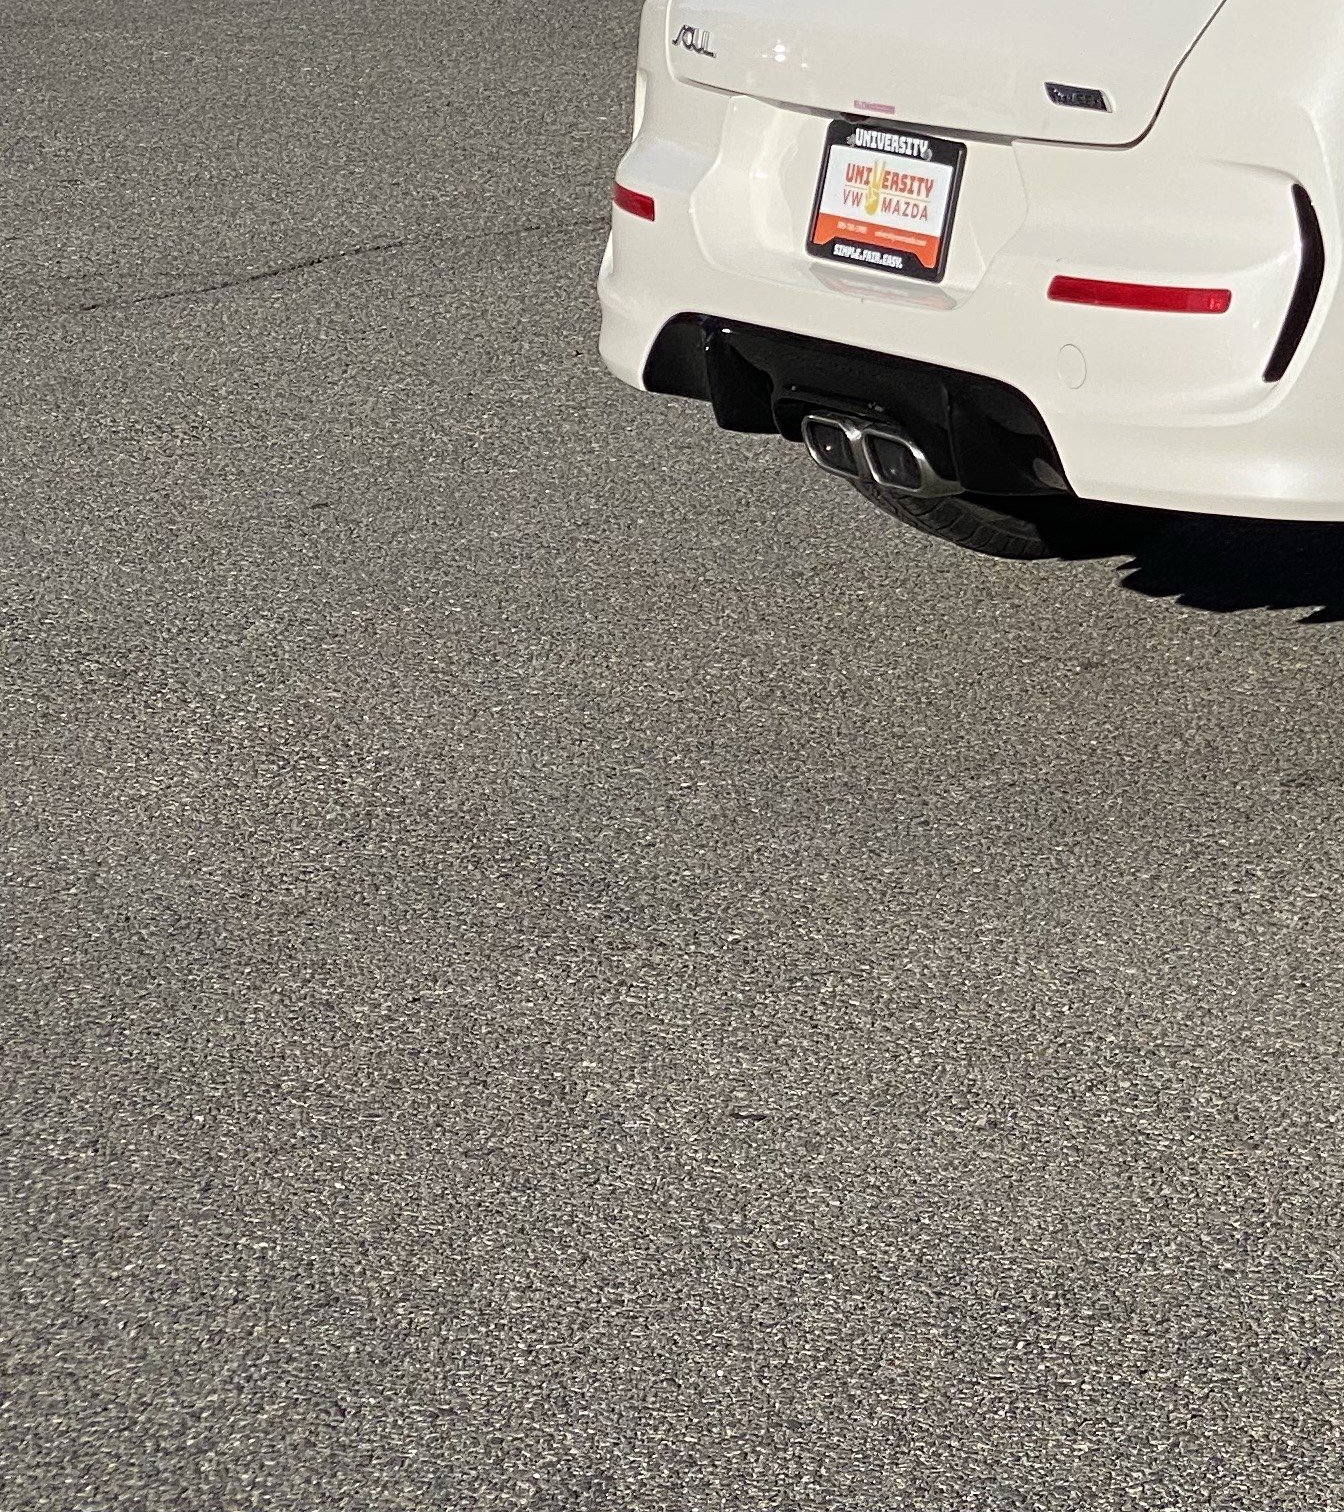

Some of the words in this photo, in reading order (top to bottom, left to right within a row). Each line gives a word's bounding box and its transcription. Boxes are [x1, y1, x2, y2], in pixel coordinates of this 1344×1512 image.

[672, 24, 717, 58] SOUL
[855, 128, 929, 155] UNIVERSITY
[843, 189, 864, 207] VW
[881, 197, 928, 221] MAZDA
